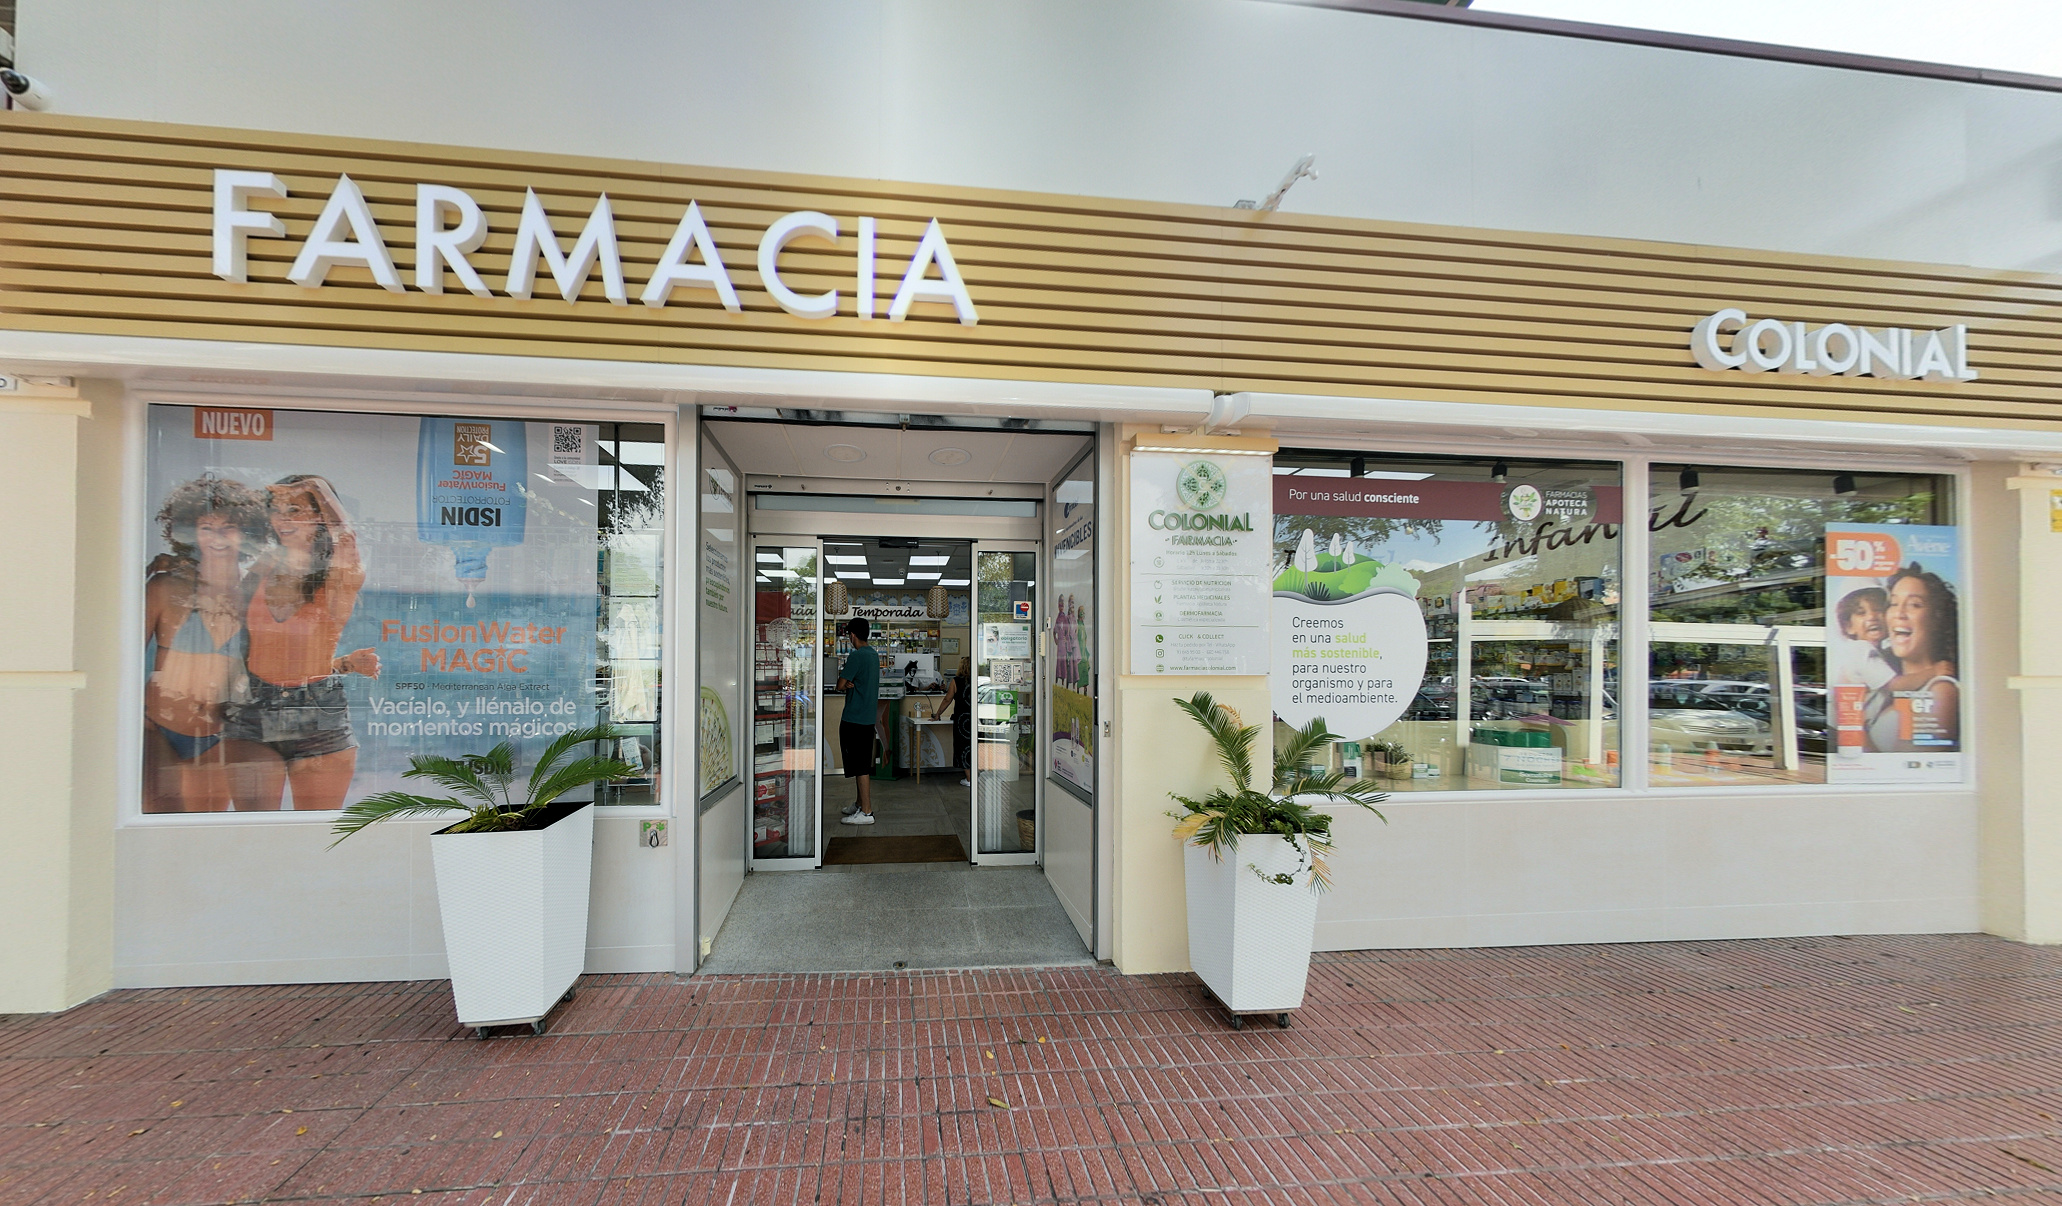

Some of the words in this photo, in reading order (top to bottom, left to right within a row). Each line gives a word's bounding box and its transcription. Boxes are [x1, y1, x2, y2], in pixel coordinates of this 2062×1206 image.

[212, 168, 980, 327] FARMACIA
[1693, 308, 1979, 382] COLONIAL
[202, 411, 265, 436] NUEVO
[456, 425, 491, 434] PROTECTION
[457, 434, 489, 442] DAILY
[474, 444, 488, 464] 5
[438, 481, 506, 491] FusionWater
[433, 496, 511, 505] FOTOPROTECTOR
[1289, 488, 1308, 500] Por
[1310, 491, 1330, 501] una
[1332, 490, 1361, 502] salud
[1363, 492, 1420, 504] consciente
[1545, 490, 1588, 499] FARMACIAS
[1545, 500, 1588, 508] APOTECA
[441, 506, 501, 527] ISDIN
[1545, 507, 1588, 516] NATURA
[1148, 509, 1254, 532] COLONIAL
[1171, 535, 1233, 546] FARMACIA
[852, 606, 924, 620] Temporada
[1292, 616, 1344, 628] Creemos
[381, 619, 568, 644] FusionWater
[1292, 634, 1306, 643] en
[1310, 634, 1331, 643] una
[1335, 632, 1367, 643] salud
[1292, 646, 1317, 658] más
[1320, 647, 1382, 660] sostenible,
[1292, 664, 1319, 676] para
[1322, 663, 1367, 674] nuestro
[395, 682, 425, 690] SPF50
[432, 682, 495, 691] Mediterranean
[519, 682, 550, 691] Extract
[1292, 677, 1354, 691] organismo
[1357, 680, 1364, 691] y
[1367, 680, 1393, 691] para
[1292, 692, 1303, 704] el
[1306, 692, 1398, 704] medioambiente.
[369, 697, 450, 717] Vacíalo,
[458, 701, 470, 718] y
[476, 697, 544, 715] llénalo
[550, 697, 577, 715] de
[368, 720, 483, 736] momentos
[489, 718, 578, 739] mágicos
[643, 822, 652, 832] P
